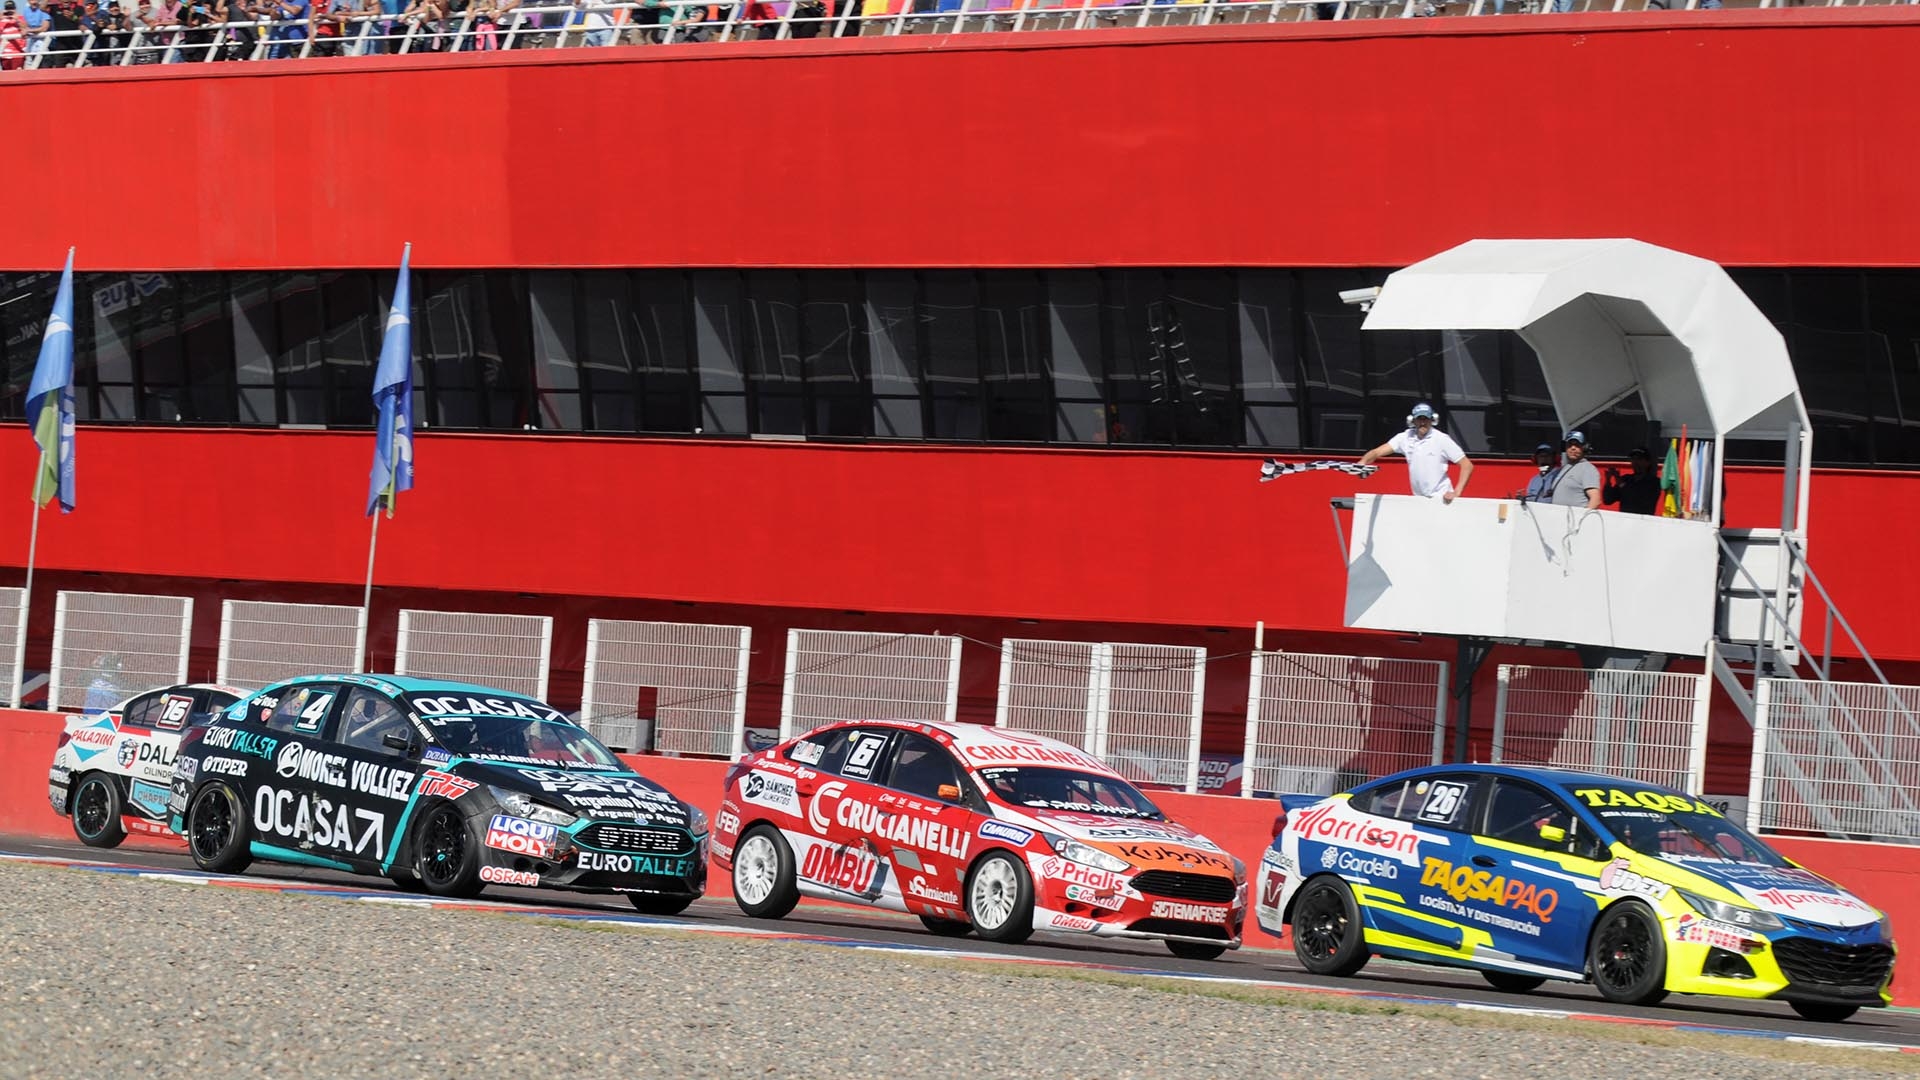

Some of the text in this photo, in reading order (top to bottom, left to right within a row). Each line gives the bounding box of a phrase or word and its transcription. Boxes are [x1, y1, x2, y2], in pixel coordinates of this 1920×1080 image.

[163, 699, 190, 723] 16
[300, 694, 333, 726] 4
[412, 697, 543, 721] OCASA
[71, 729, 116, 747] PALADINI
[202, 726, 278, 760] EUROTALLER
[848, 737, 882, 767] 6
[299, 749, 415, 802] MOREL VULLIEZ
[418, 769, 480, 799] TRW
[1425, 785, 1461, 815] 26
[1575, 789, 1725, 819] TAQSA
[254, 785, 353, 852] OCASA
[492, 816, 555, 842] LIQUI
[836, 797, 972, 861] CRUCIANELLI
[1293, 804, 1418, 854] Morrison
[488, 832, 548, 857] MOLY
[481, 866, 538, 886] OSRAM
[577, 852, 695, 877] EUROTALLER
[1062, 862, 1124, 893] Prialis
[1338, 851, 1398, 880] Gardella
[1051, 914, 1095, 930] OMBU
[1150, 900, 1229, 923] SISTEMAFREE
[1466, 907, 1475, 918] Y
[1474, 910, 1541, 936] DISTRIBUCIÓN
[1735, 910, 1752, 924] 26
